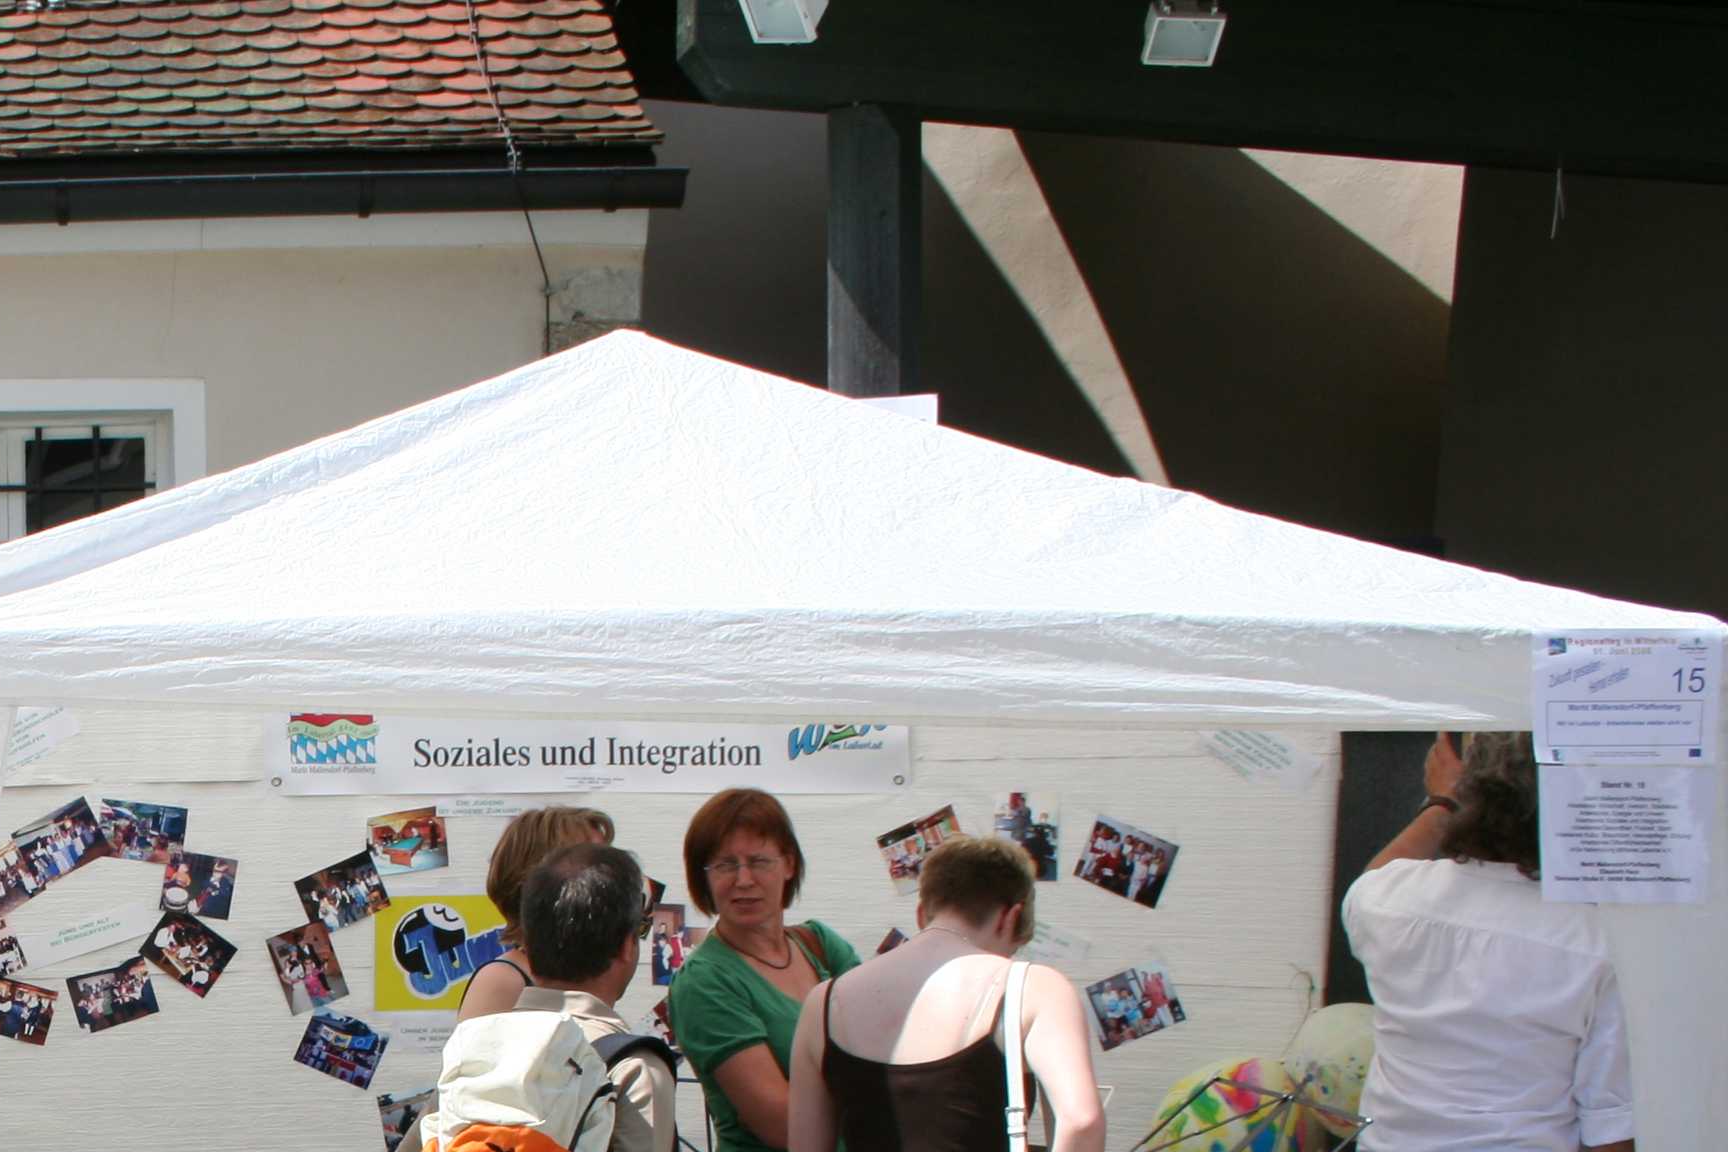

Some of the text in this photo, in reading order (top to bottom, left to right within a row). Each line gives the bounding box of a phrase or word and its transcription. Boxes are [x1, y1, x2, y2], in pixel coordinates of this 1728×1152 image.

[1672, 667, 1705, 693] 15
[413, 737, 530, 768] Soziales
[540, 737, 595, 767] und
[607, 737, 762, 775] Integration
